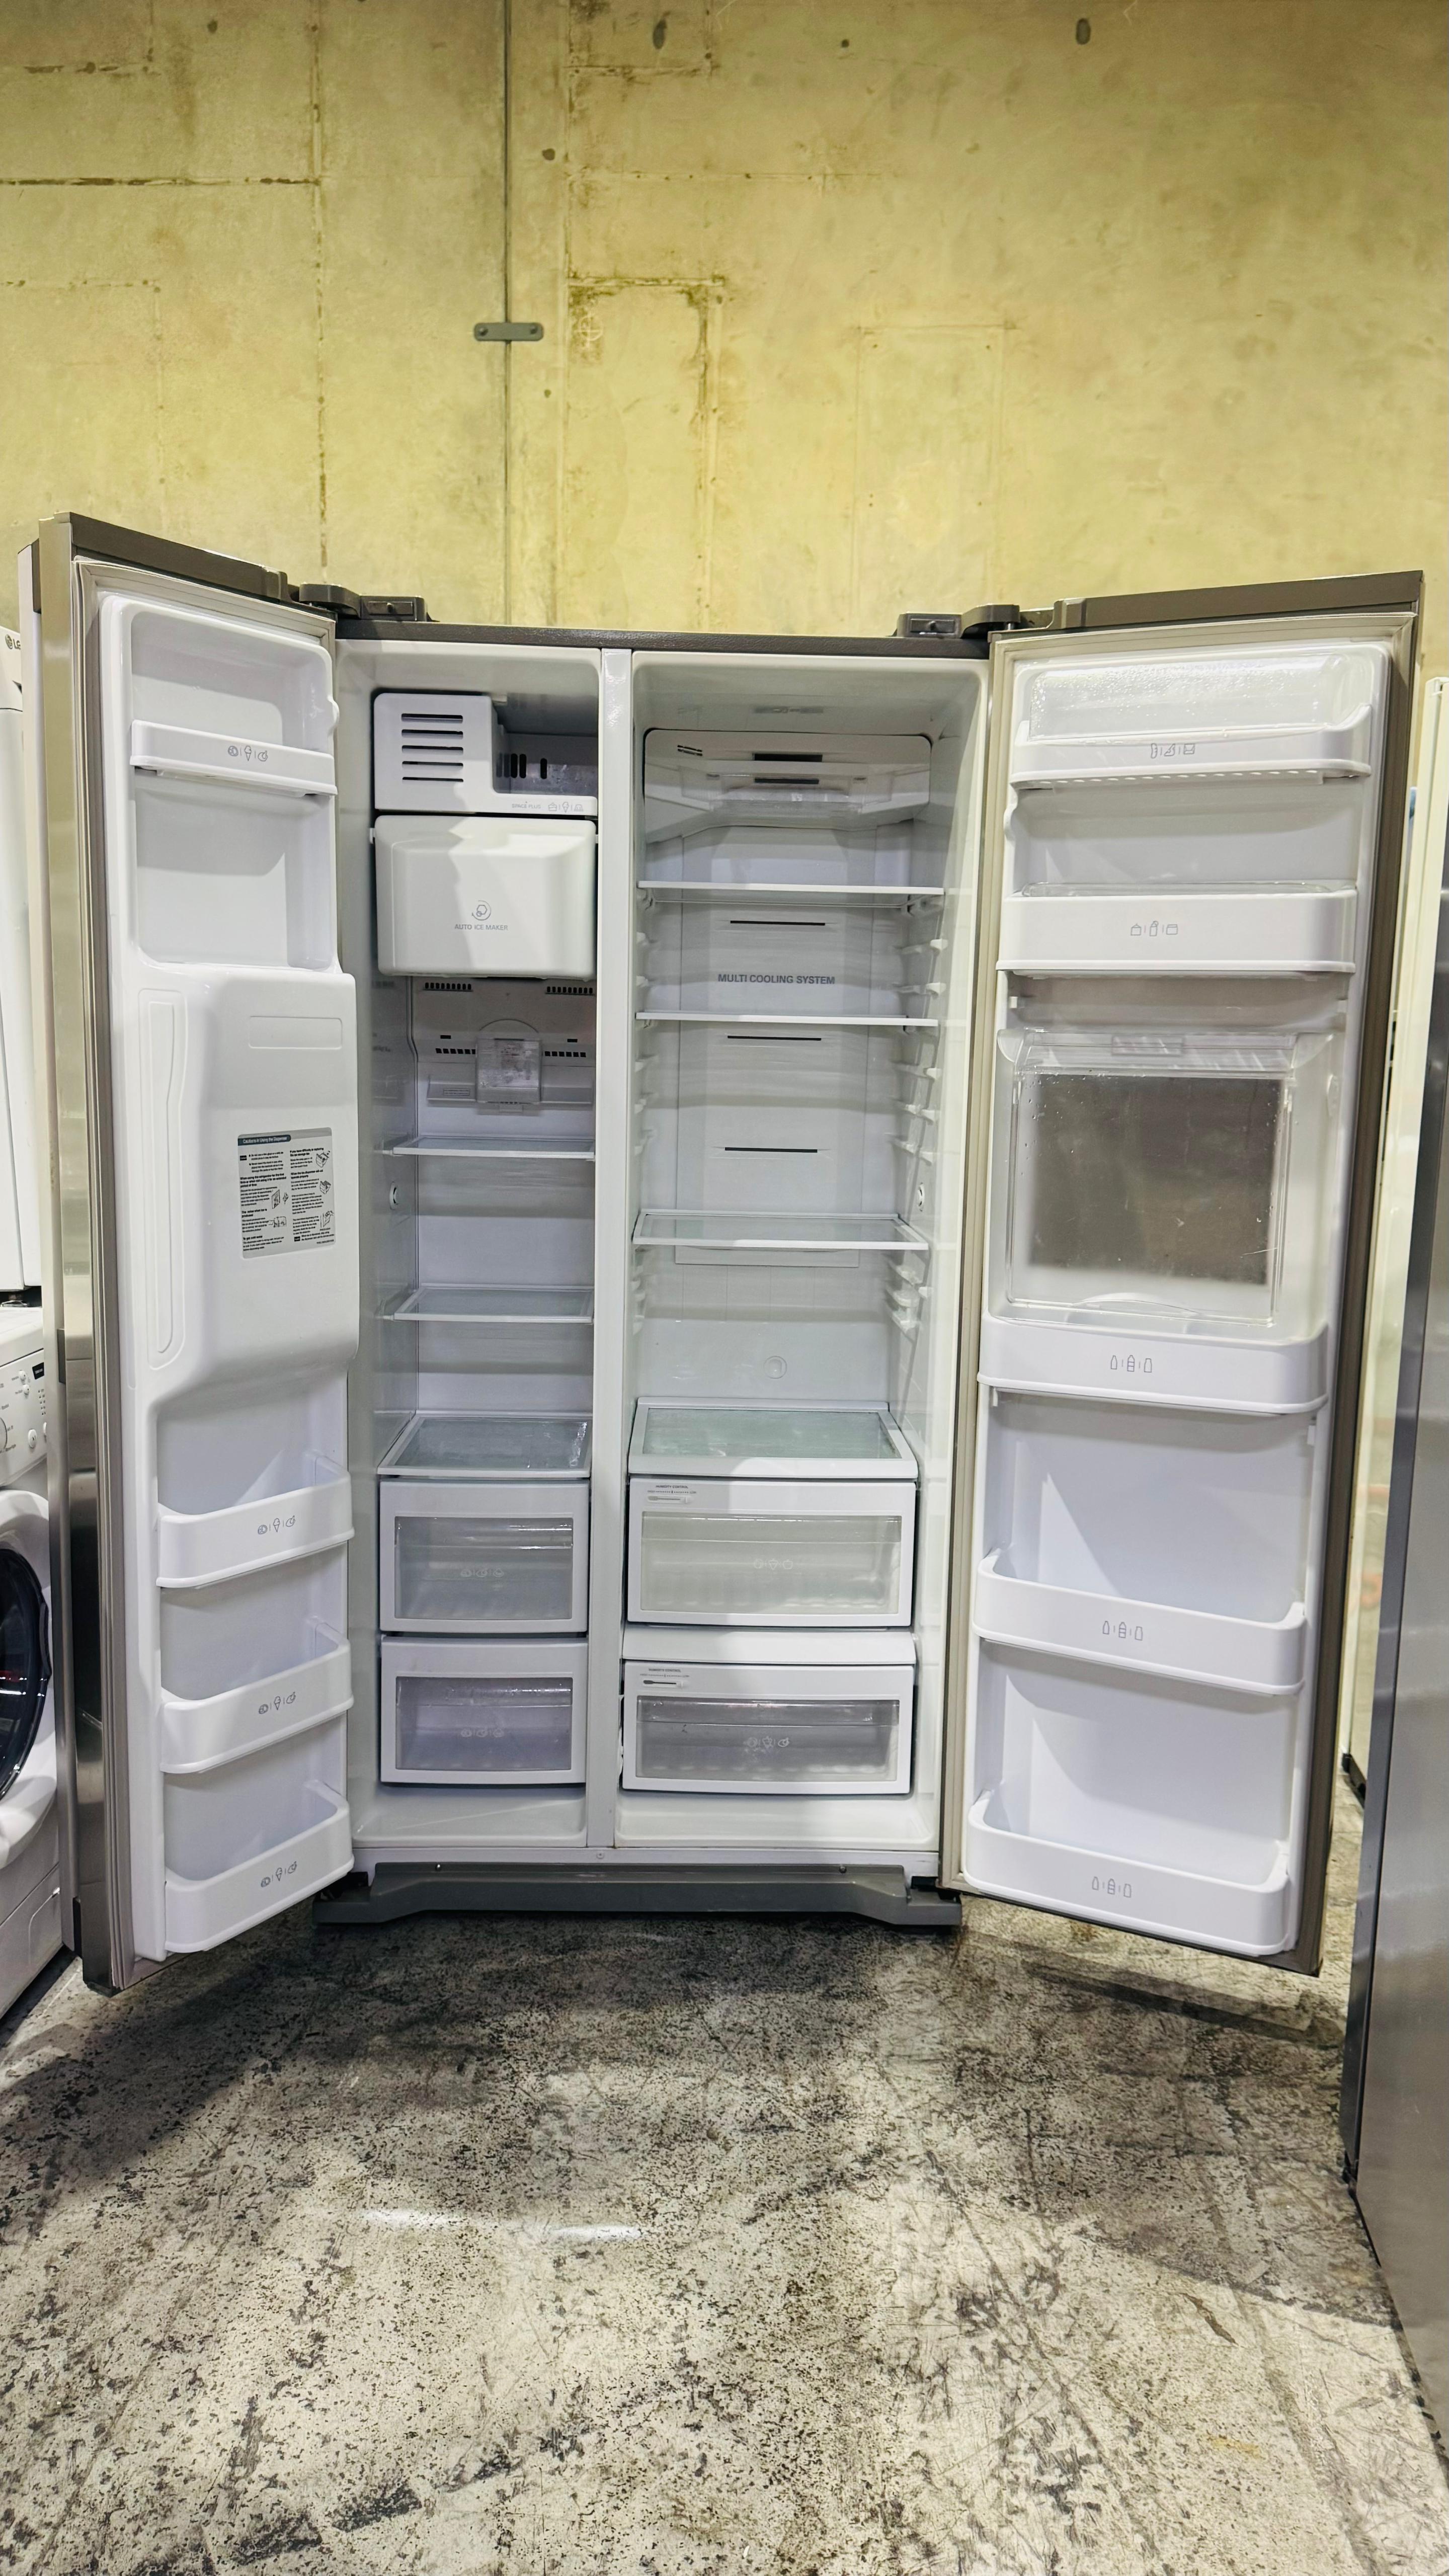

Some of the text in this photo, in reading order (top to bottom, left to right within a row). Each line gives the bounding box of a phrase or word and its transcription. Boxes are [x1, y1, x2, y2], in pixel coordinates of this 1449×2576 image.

[717, 974, 836, 985] MULTI COOLING SYSTEM
